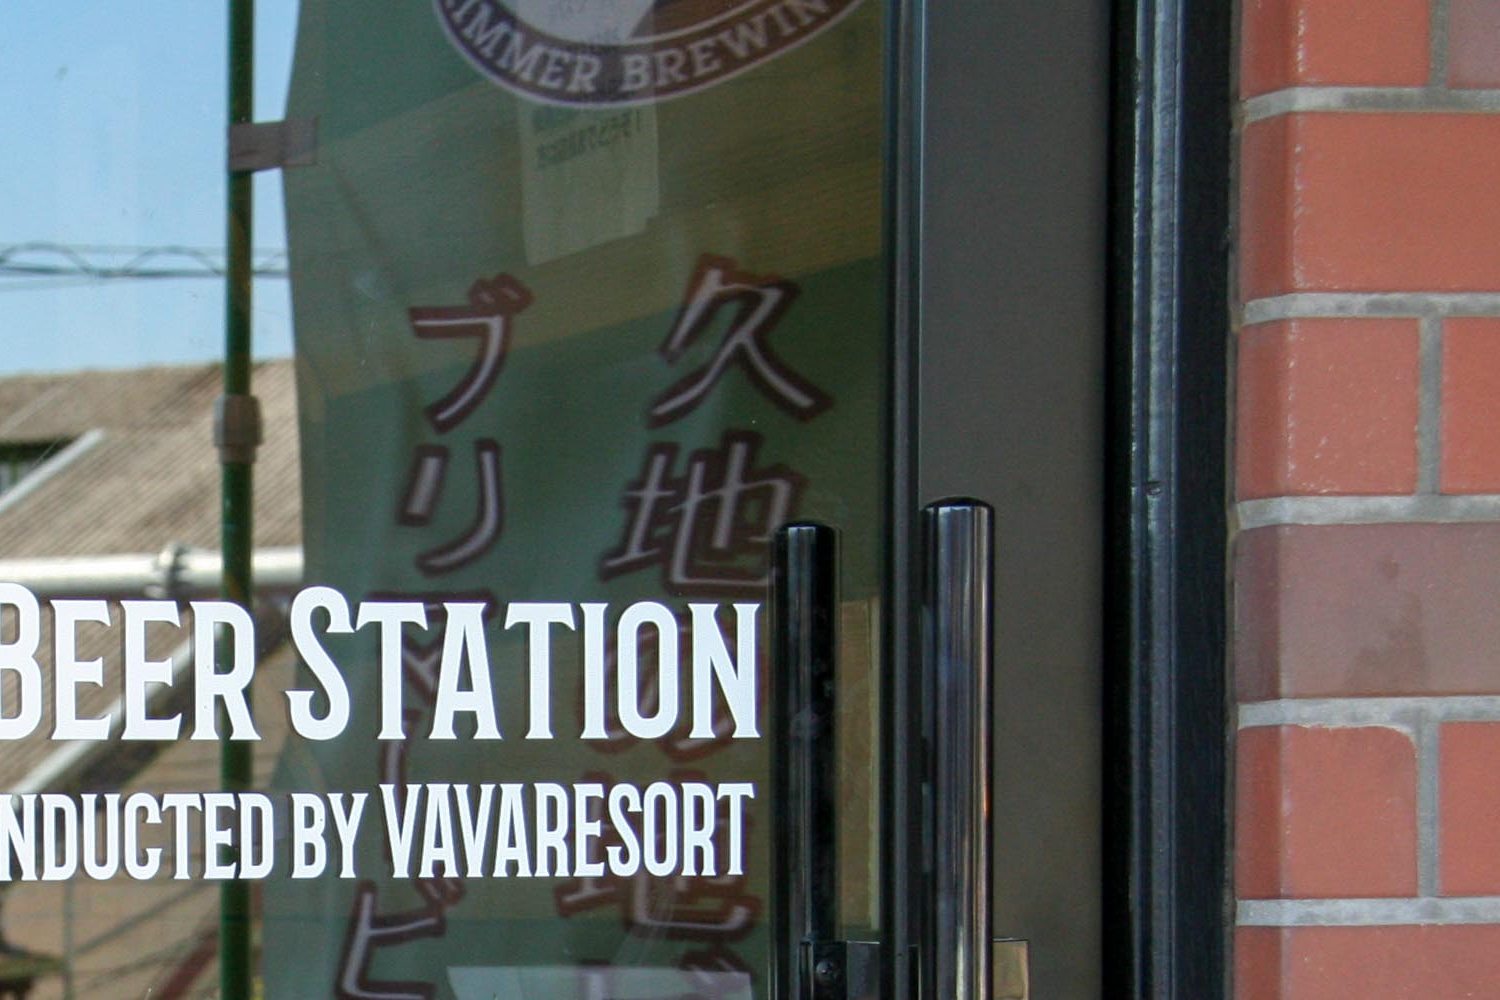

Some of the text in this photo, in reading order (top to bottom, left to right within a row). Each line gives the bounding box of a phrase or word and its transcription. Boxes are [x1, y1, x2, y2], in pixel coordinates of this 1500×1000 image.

[286, 585, 761, 741] STATION
[291, 793, 368, 879] BY
[379, 782, 755, 879] VAVARESORT
